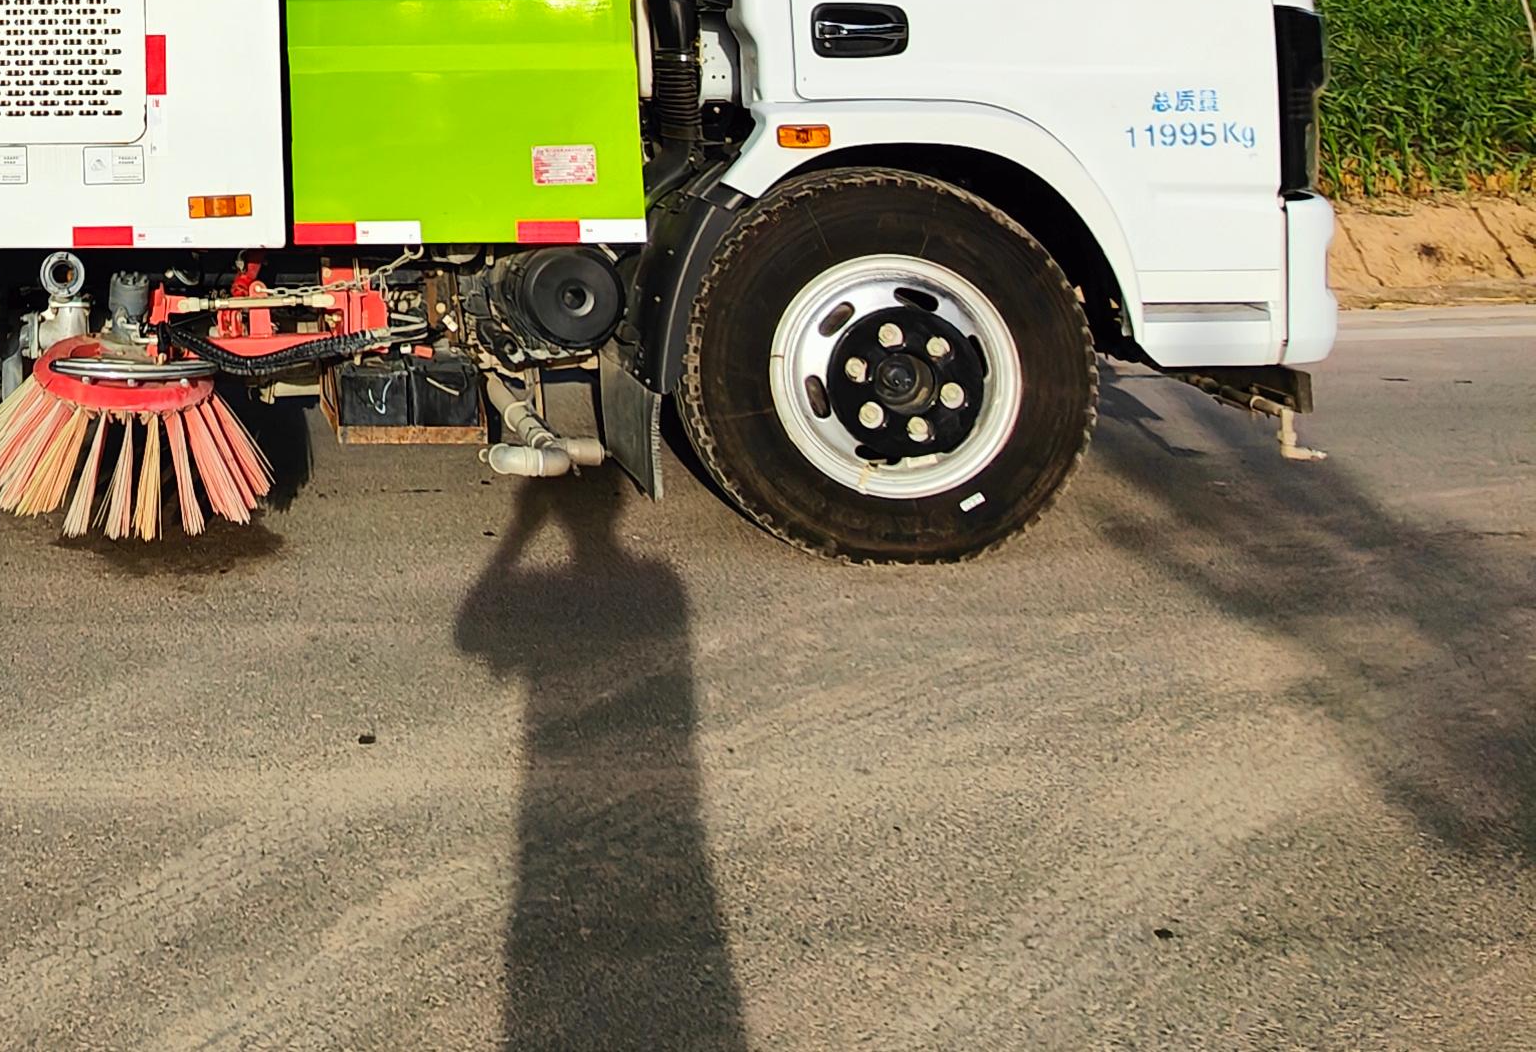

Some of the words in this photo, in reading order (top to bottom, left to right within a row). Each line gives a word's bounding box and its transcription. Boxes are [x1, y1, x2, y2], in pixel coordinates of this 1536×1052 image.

[1151, 89, 1220, 113] 总质量
[1125, 122, 1256, 149] 11995Kg
